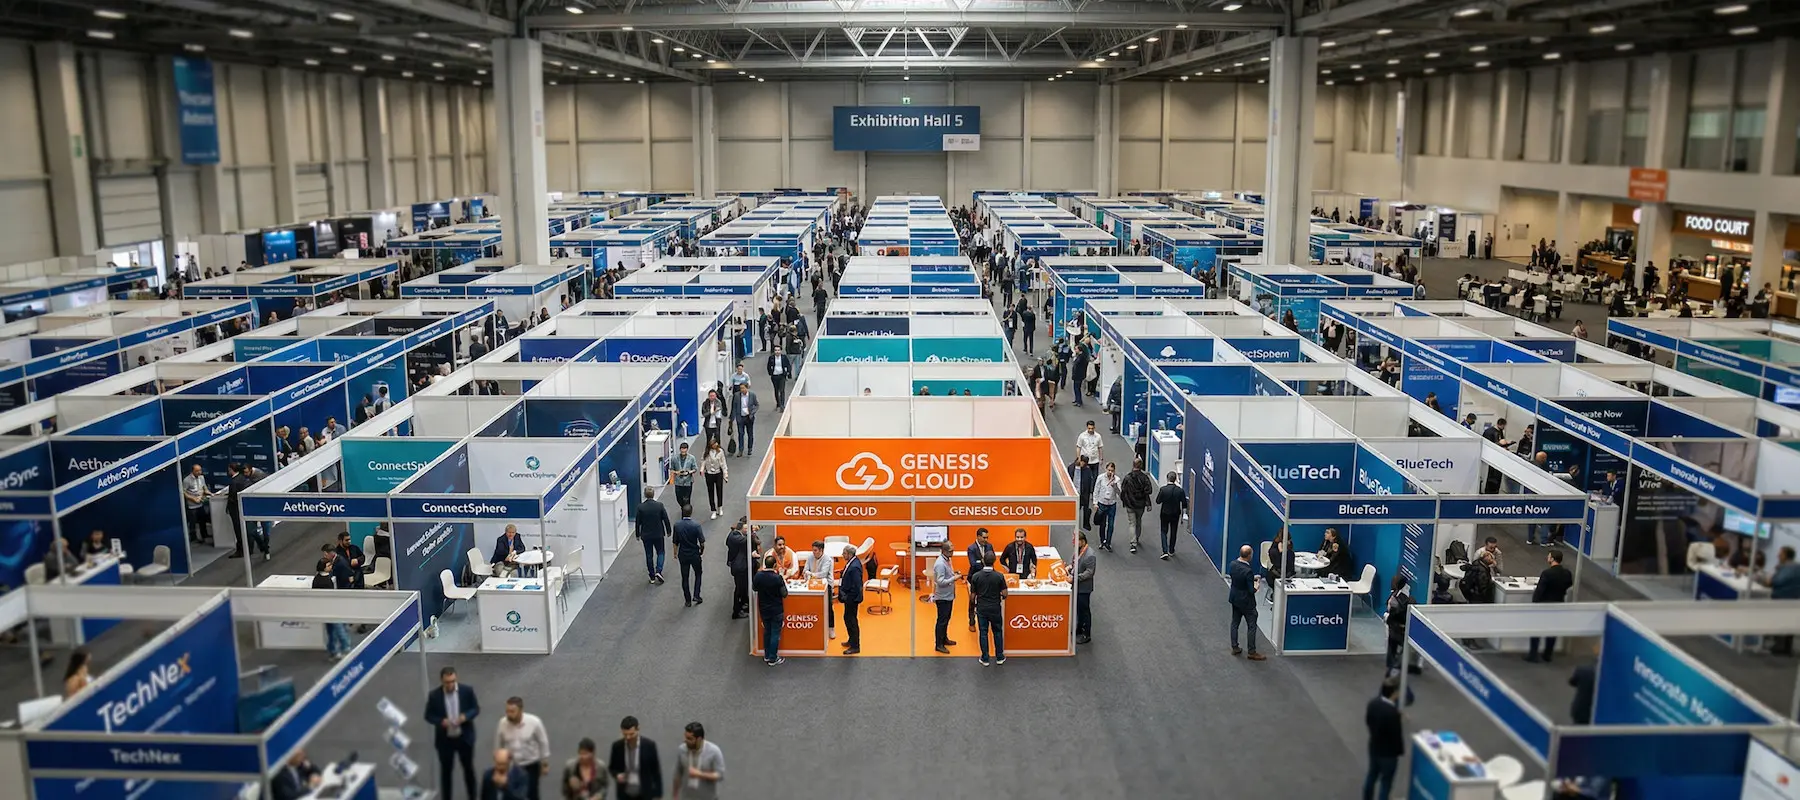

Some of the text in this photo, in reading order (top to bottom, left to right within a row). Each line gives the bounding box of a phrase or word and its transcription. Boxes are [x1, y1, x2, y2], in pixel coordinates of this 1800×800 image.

[850, 114, 963, 127] Exhibition Hall 5
[1685, 215, 1750, 236] FOOD COURT
[1604, 410, 1623, 418] Now
[900, 453, 989, 470] GENESIS
[1396, 458, 1454, 470] BlueTech
[97, 463, 139, 489] AetherSync
[1262, 464, 1341, 480] BlueTech
[900, 473, 974, 490] CLOUD
[1698, 476, 1716, 492] Now
[283, 501, 346, 514] AetherSync
[422, 502, 508, 515] ConnectSphere
[783, 506, 878, 517] GENESIS CLOUD
[949, 506, 1043, 516] GENESIS CLOUD
[1338, 503, 1389, 515] BlueTech
[1474, 503, 1550, 515] Innovate Now
[786, 614, 818, 623] GENESIS
[1031, 614, 1064, 622] GENESIS
[1290, 614, 1344, 626] BlueTech
[786, 621, 814, 629] CLOUD
[1031, 621, 1059, 629] CLOUD
[1633, 655, 1689, 709] Innovate
[97, 651, 192, 734] TechNex
[110, 748, 182, 765] TechNex
